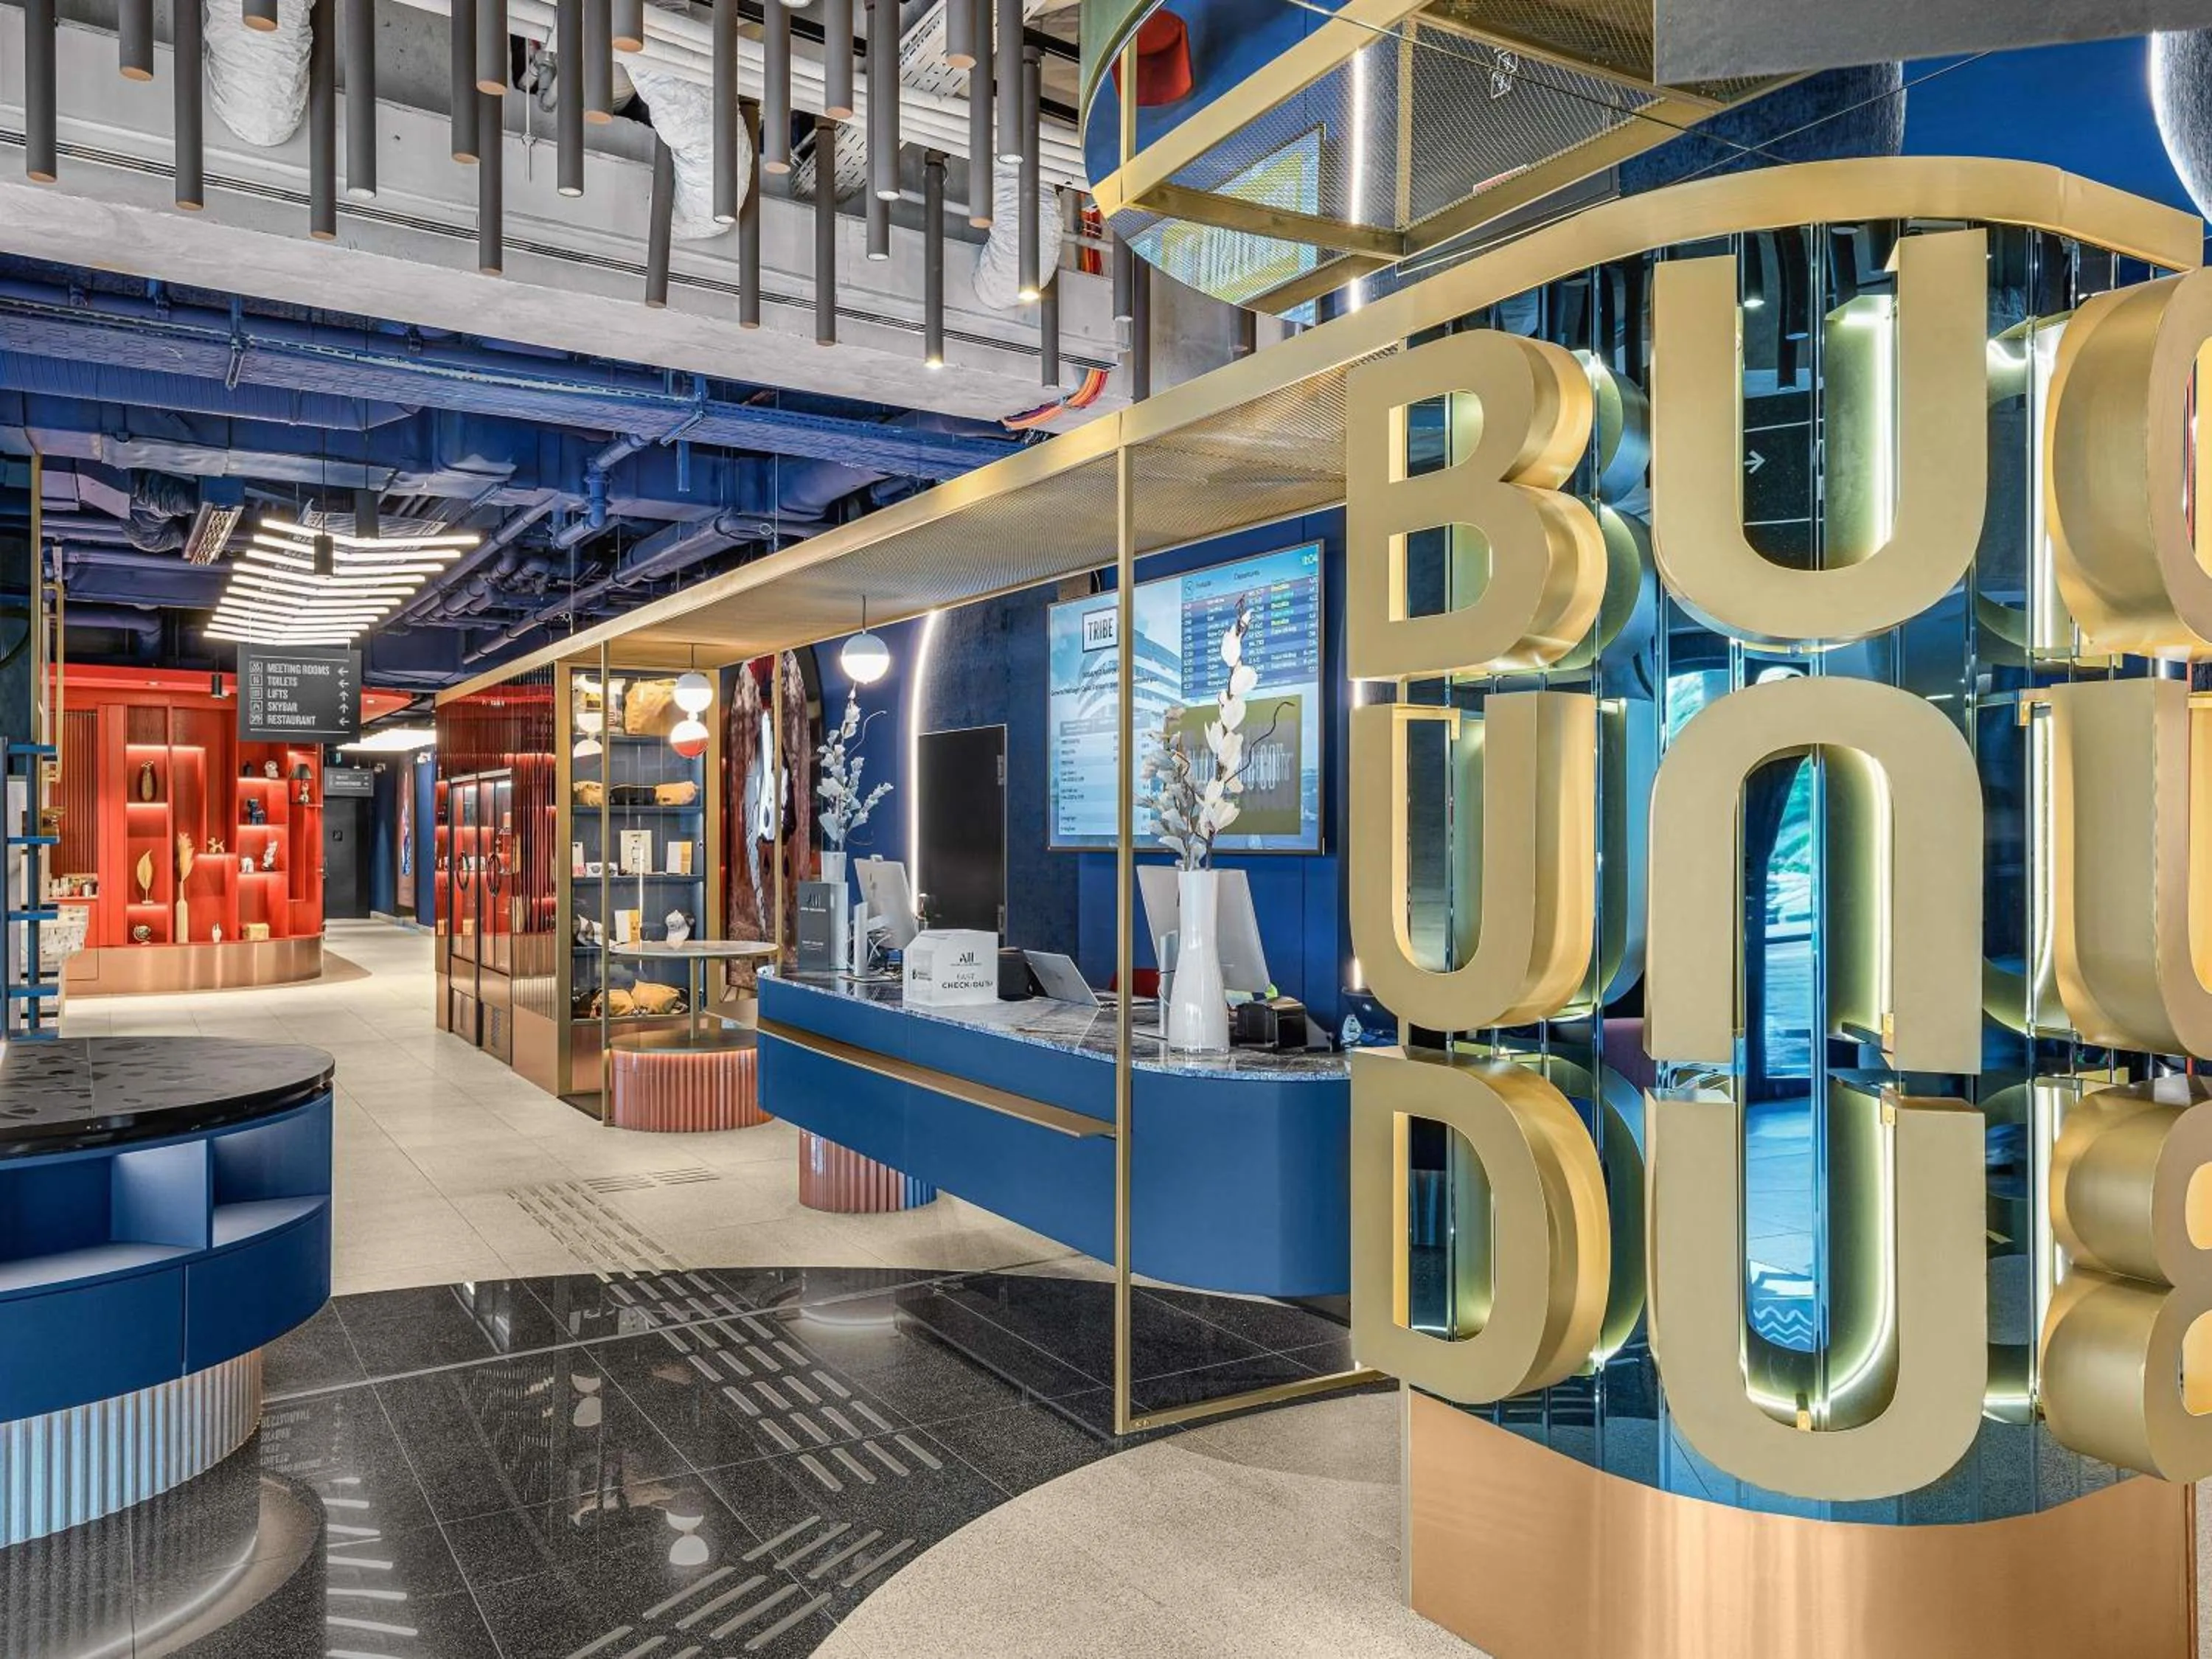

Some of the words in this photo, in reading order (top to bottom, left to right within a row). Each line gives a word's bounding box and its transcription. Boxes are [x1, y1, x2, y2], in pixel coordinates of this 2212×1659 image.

[1088, 617, 1113, 641] TRIBE
[268, 664, 302, 674] MEETING
[302, 664, 330, 675] ROOMS
[268, 676, 298, 686] TOILETS
[268, 688, 288, 699] LIFTS
[268, 701, 298, 712] SKYBAR
[268, 714, 316, 726] RESTAURANT
